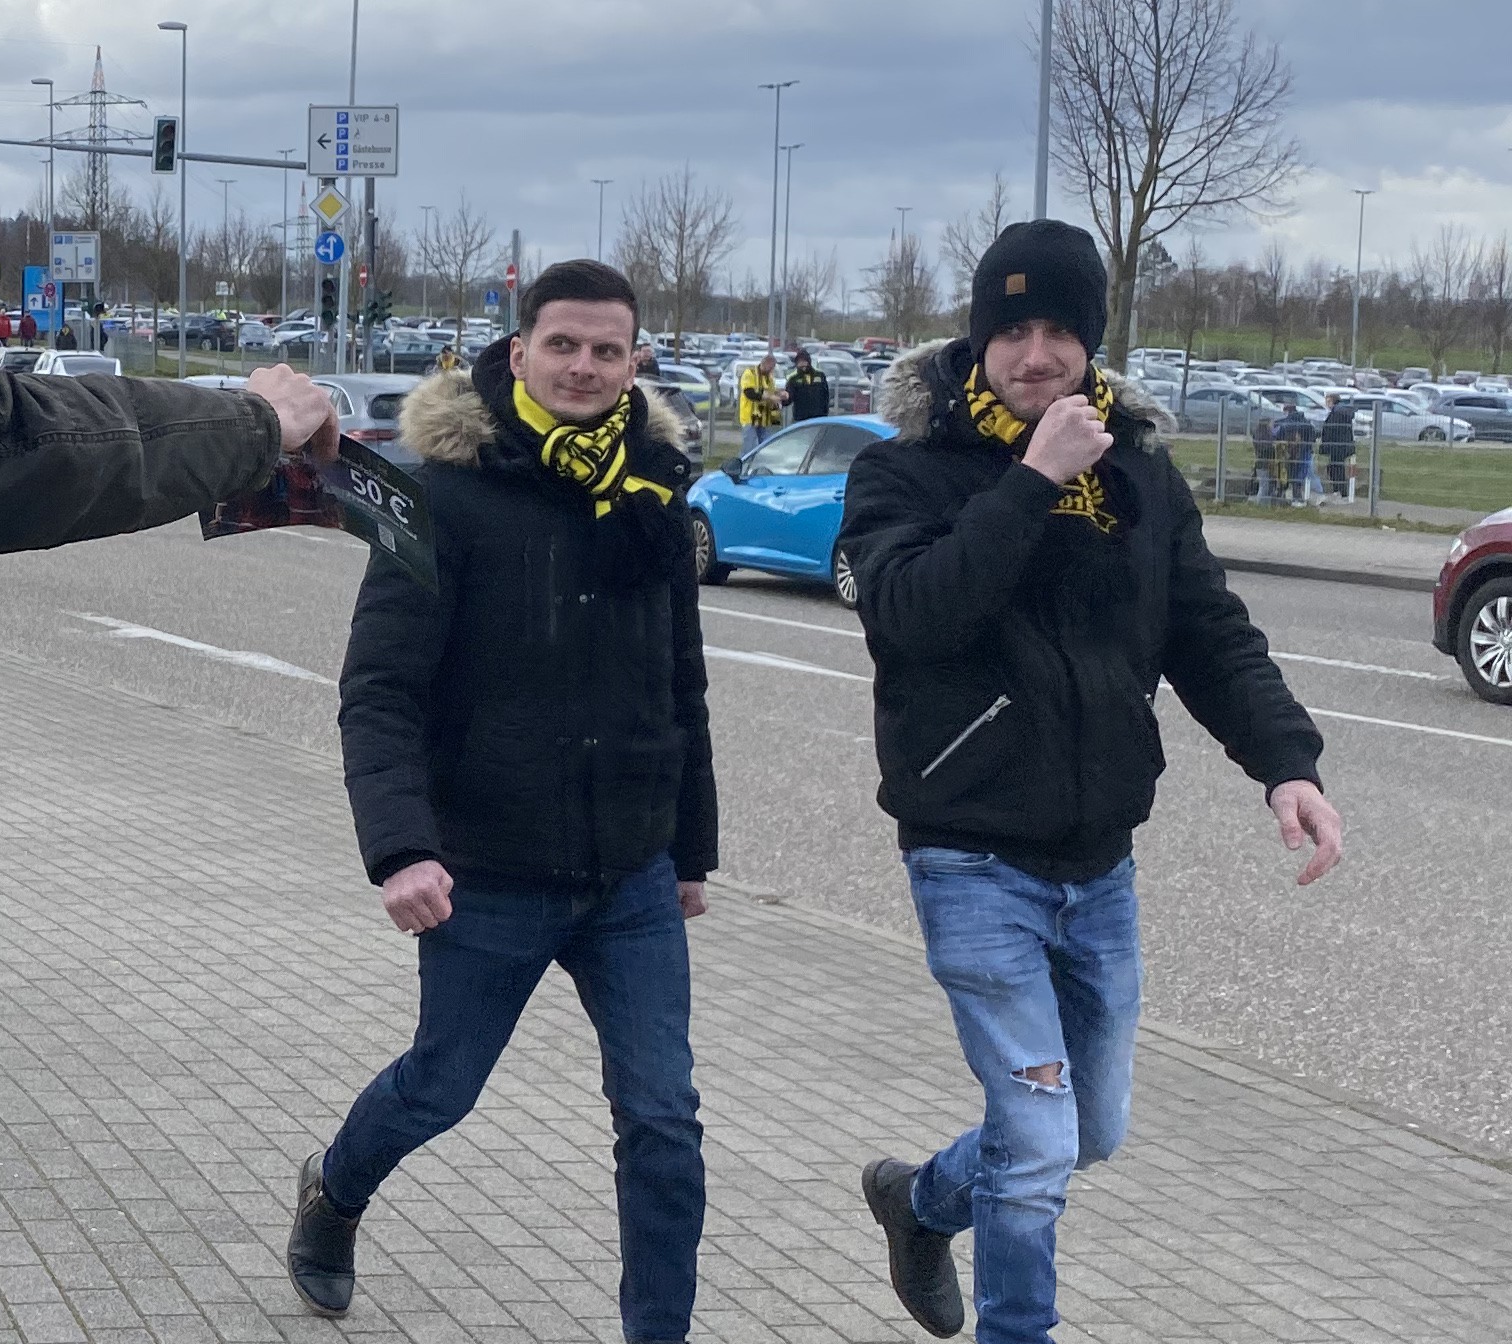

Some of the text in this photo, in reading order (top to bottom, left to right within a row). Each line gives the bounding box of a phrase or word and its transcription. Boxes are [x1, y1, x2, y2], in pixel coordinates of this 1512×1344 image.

[353, 113, 369, 123] VIP
[352, 159, 386, 169] Presse
[349, 467, 383, 506] 50
[388, 494, 409, 524] €
